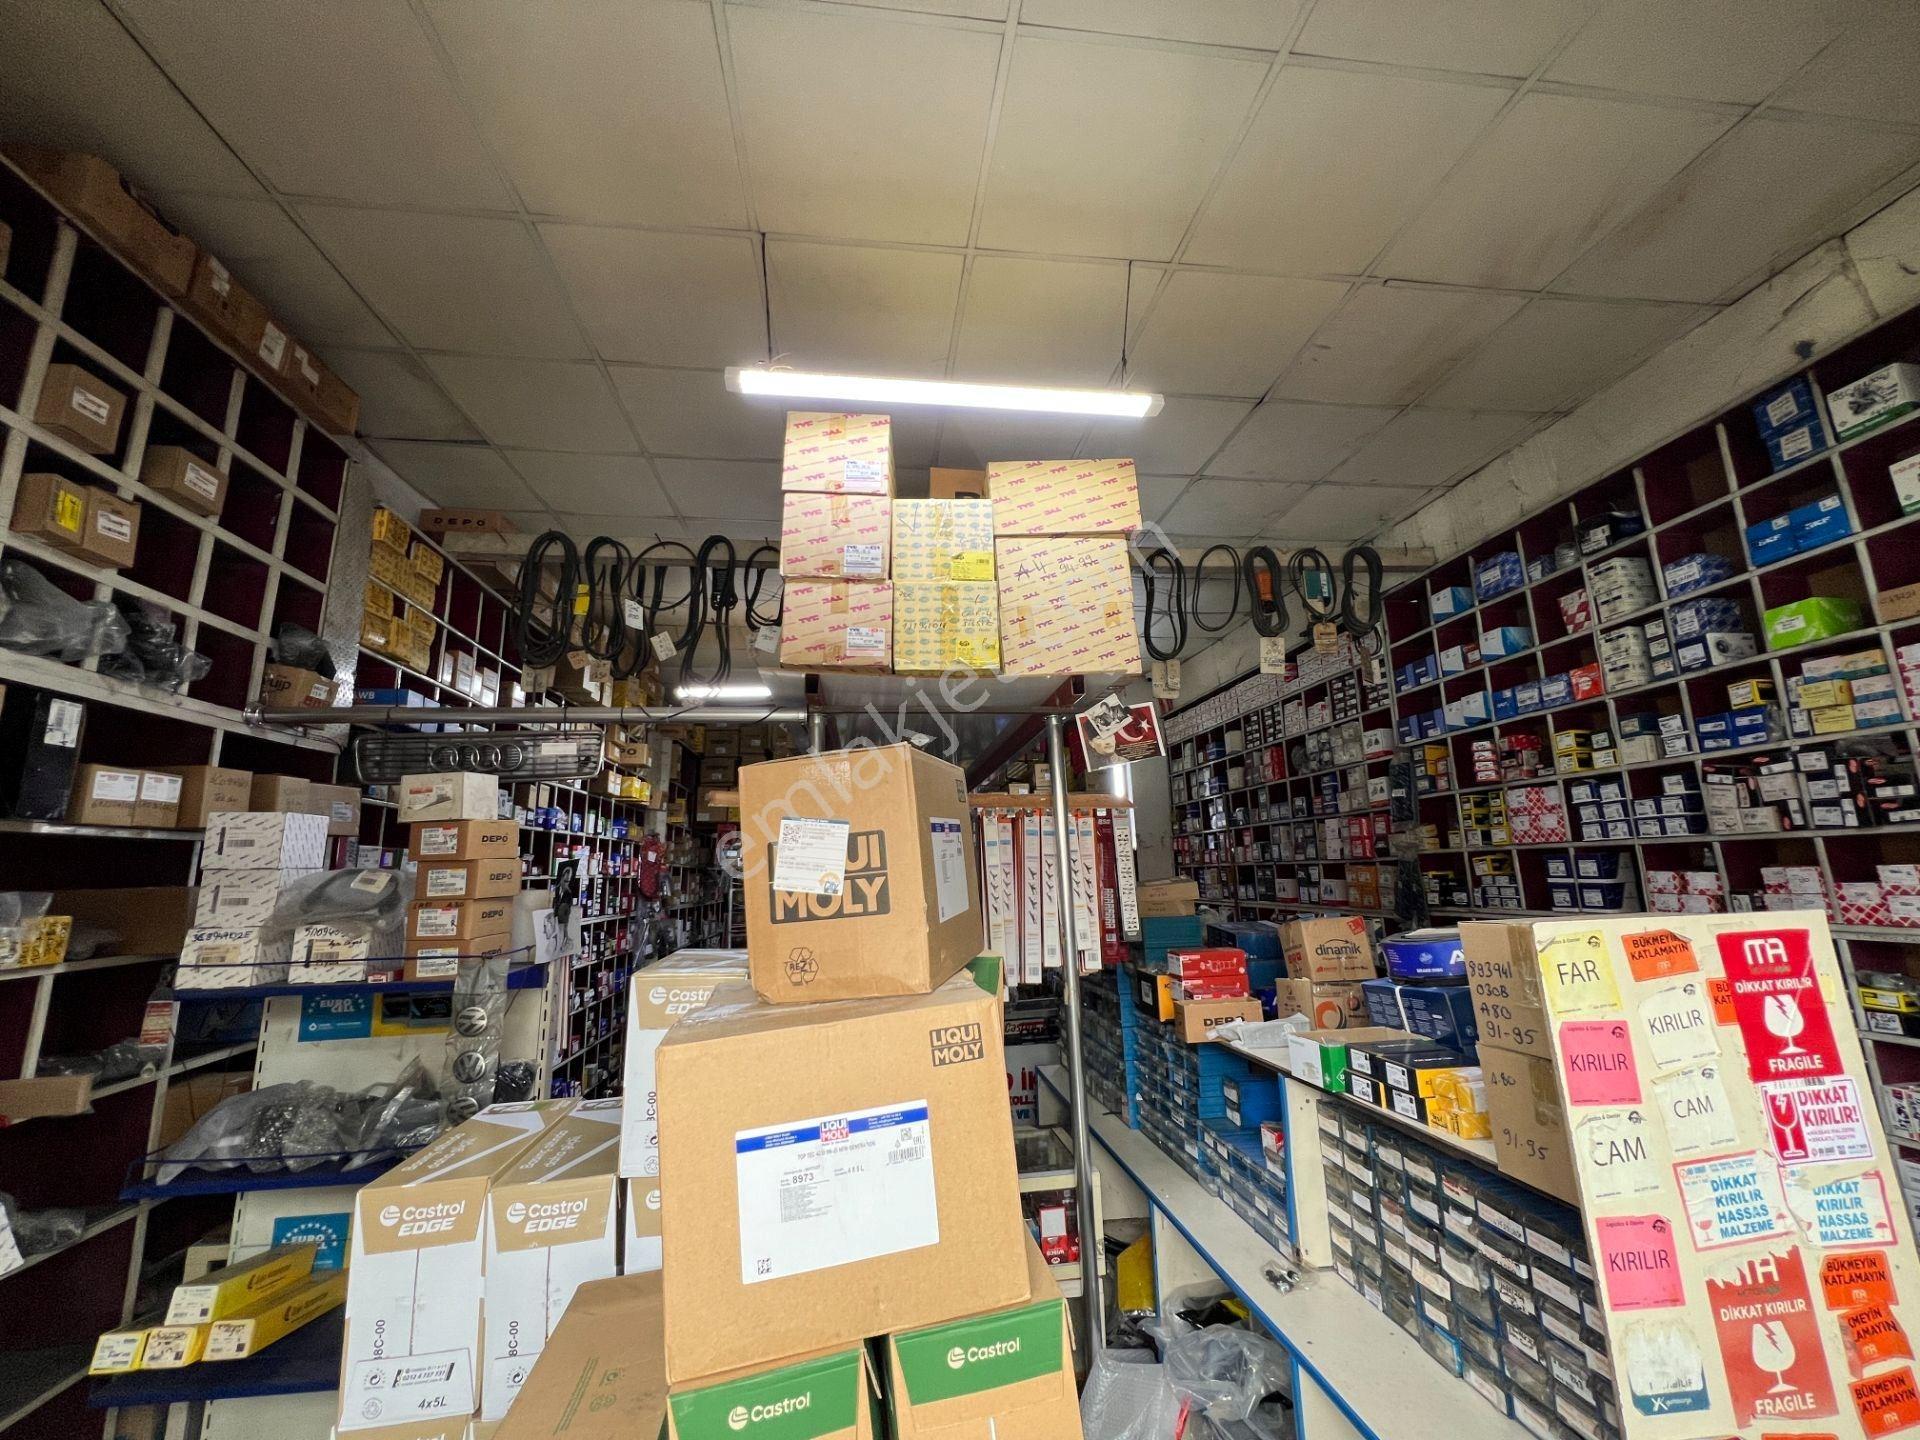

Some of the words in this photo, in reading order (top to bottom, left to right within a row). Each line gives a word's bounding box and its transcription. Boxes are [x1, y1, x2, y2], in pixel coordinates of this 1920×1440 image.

[434, 517, 486, 526] DEPO
[775, 876, 886, 920] MOLY
[481, 910, 504, 919] DEPO
[1316, 942, 1361, 955] dinamik
[1631, 944, 1689, 961] KATLAMAYIN
[790, 961, 814, 971] REZY
[1468, 960, 1512, 978] 893941
[1556, 960, 1601, 986] FAR
[1735, 980, 1774, 994] DİKKAT
[1776, 977, 1813, 990] KIRILIR
[320, 999, 352, 1008] EURO
[1480, 1003, 1512, 1020] A80
[1648, 1009, 1704, 1036] KIRILIR
[932, 1024, 980, 1046] LIQUI
[1487, 1021, 1538, 1044] 91-95
[934, 1042, 981, 1064] MOLY
[1570, 1053, 1628, 1072] KIRILIR
[1769, 1055, 1824, 1072] FRAGILE
[1799, 1086, 1848, 1106] DİKKAT
[1673, 1096, 1714, 1118] CAM
[1803, 1106, 1860, 1127] KIRILIR!
[820, 1118, 848, 1131] LIQUI
[821, 1130, 850, 1142] MOLY
[792, 1173, 814, 1184] 8973
[1710, 1174, 1757, 1192] DİKKAT
[528, 1198, 588, 1218] Castrol
[1715, 1190, 1763, 1208] KIRILIR
[1816, 1197, 1863, 1212] KIRILIR
[402, 1200, 466, 1220] Castrol
[1718, 1205, 1770, 1224] HASSAS
[398, 1218, 456, 1237] EDGE
[524, 1215, 578, 1234] EDGE
[1720, 1220, 1774, 1239] MALZEME
[1818, 1213, 1869, 1228] HASSAS
[1820, 1228, 1873, 1242] MALZEME
[1609, 1250, 1670, 1272] KIRILIR
[1826, 1256, 1878, 1272] BÜKMEYİN
[1824, 1270, 1886, 1286] KATLAMAYIN
[1720, 1304, 1762, 1322] DİKKAT
[1766, 1299, 1807, 1316] KIRILIR
[968, 1338, 1020, 1362] Castrol
[1855, 1376, 1906, 1399] BÜKMEYİN
[751, 1393, 810, 1422] Castrol
[1755, 1393, 1816, 1414] FRAGILE
[1862, 1388, 1916, 1414] ATLAMAYIN
